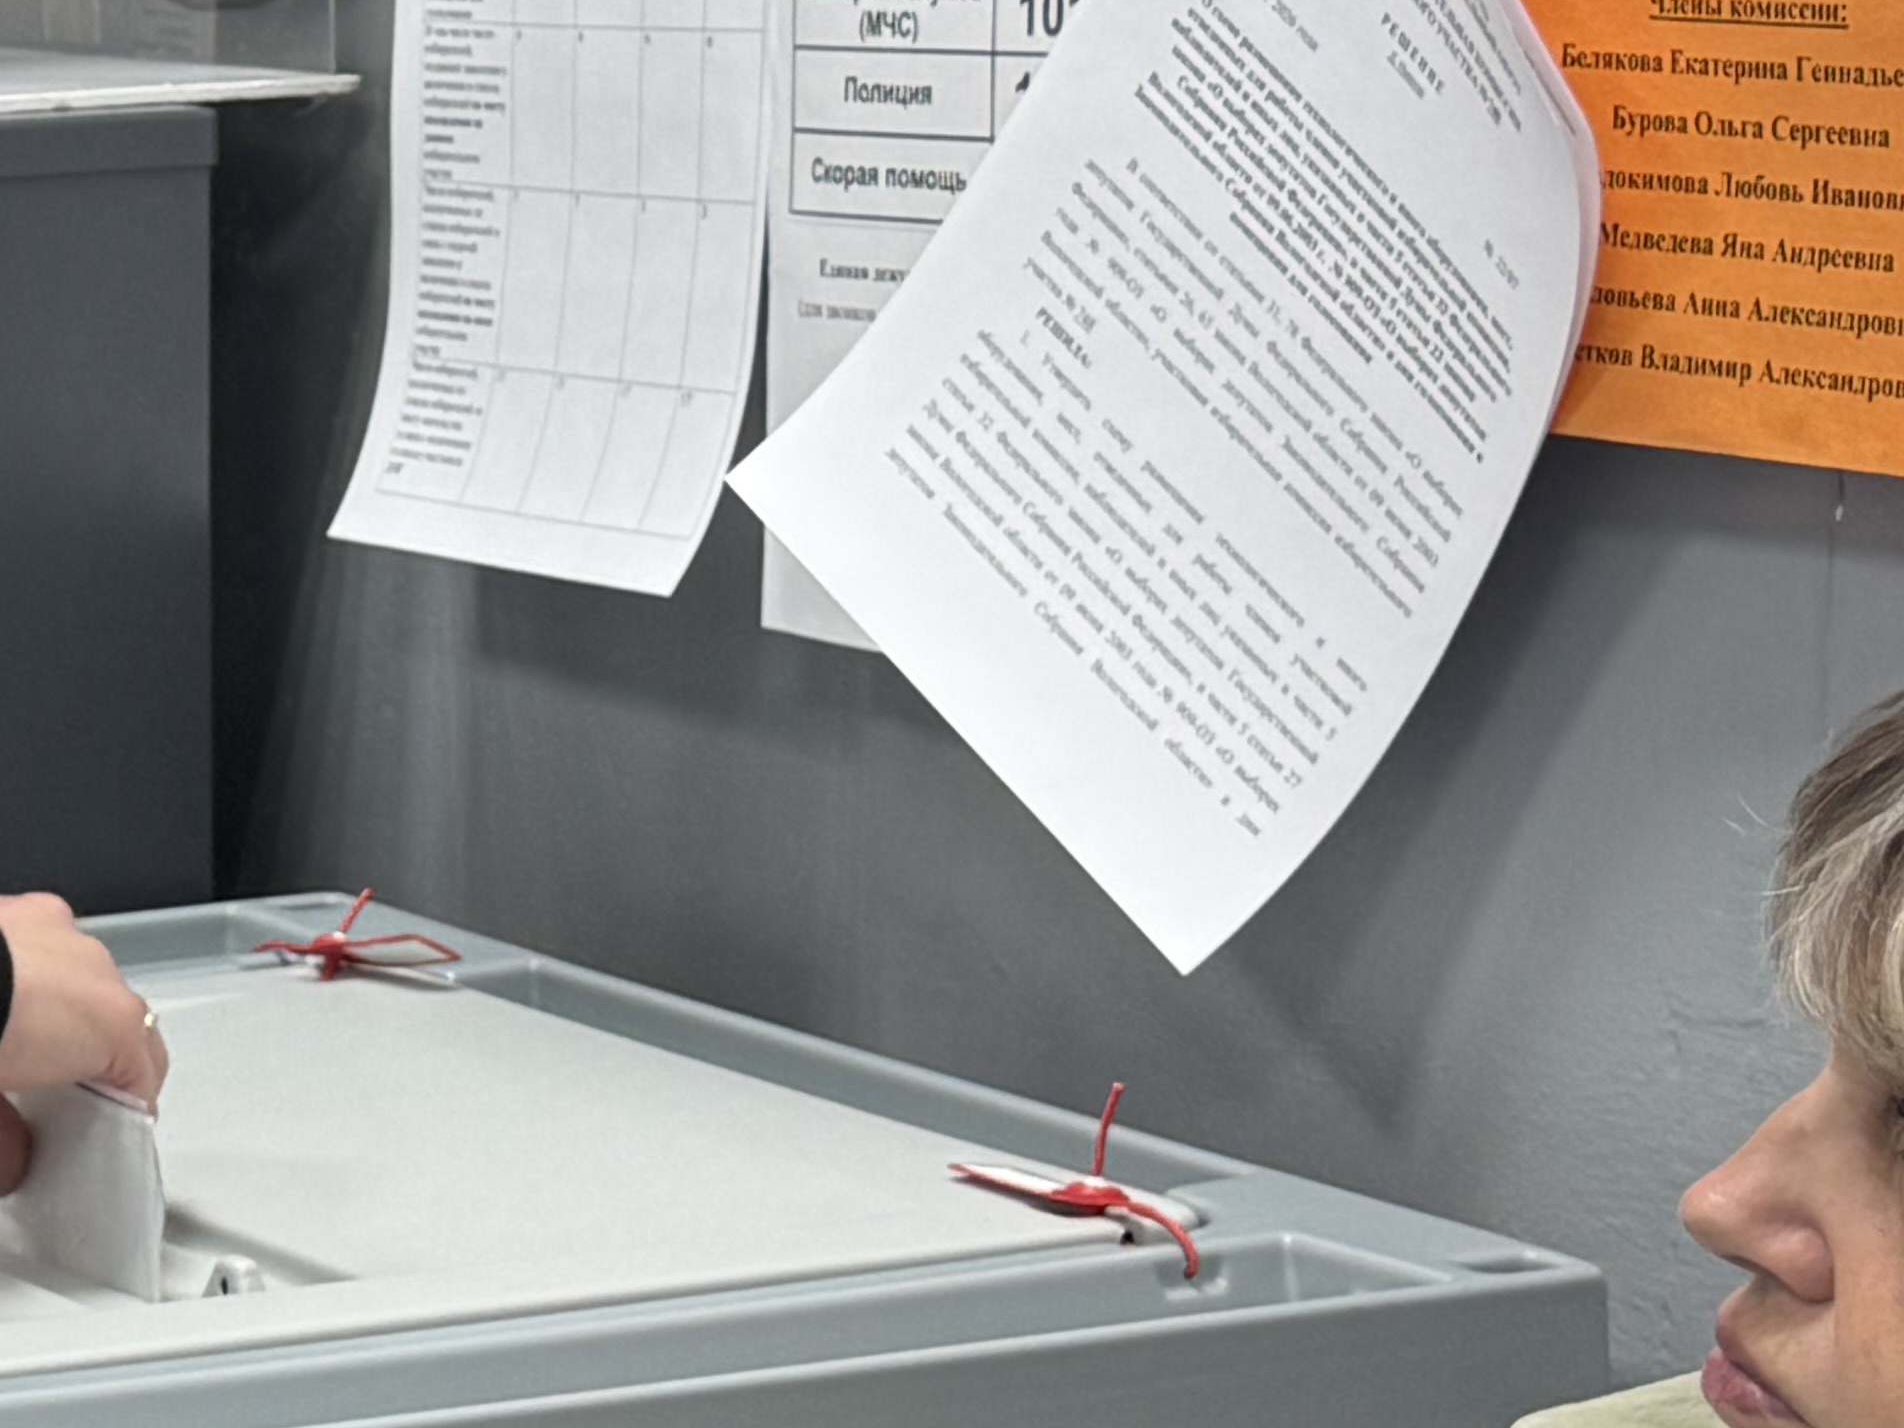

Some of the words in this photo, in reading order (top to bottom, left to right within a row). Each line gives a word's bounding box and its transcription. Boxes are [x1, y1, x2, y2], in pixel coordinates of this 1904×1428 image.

[859, 10, 919, 43] (МЧС)
[1562, 43, 1663, 73] Белякова
[1670, 49, 1788, 86] Екатерина
[844, 76, 932, 109] Полиция
[1612, 105, 1688, 136] Бурова
[1695, 111, 1763, 140] Ольга
[1771, 116, 1890, 149] Сергеевна
[811, 158, 879, 191] Скорая
[885, 162, 967, 193] помощь
[1601, 170, 1708, 195] докимова
[1715, 170, 1804, 203] Любовь
[1600, 222, 1713, 256] Медведева
[1721, 233, 1764, 260] Яна
[1772, 238, 1895, 273] Андреевна
[1591, 286, 1676, 311] ловьева
[1683, 292, 1740, 319] Анна
[1641, 344, 1752, 387] Владимир
